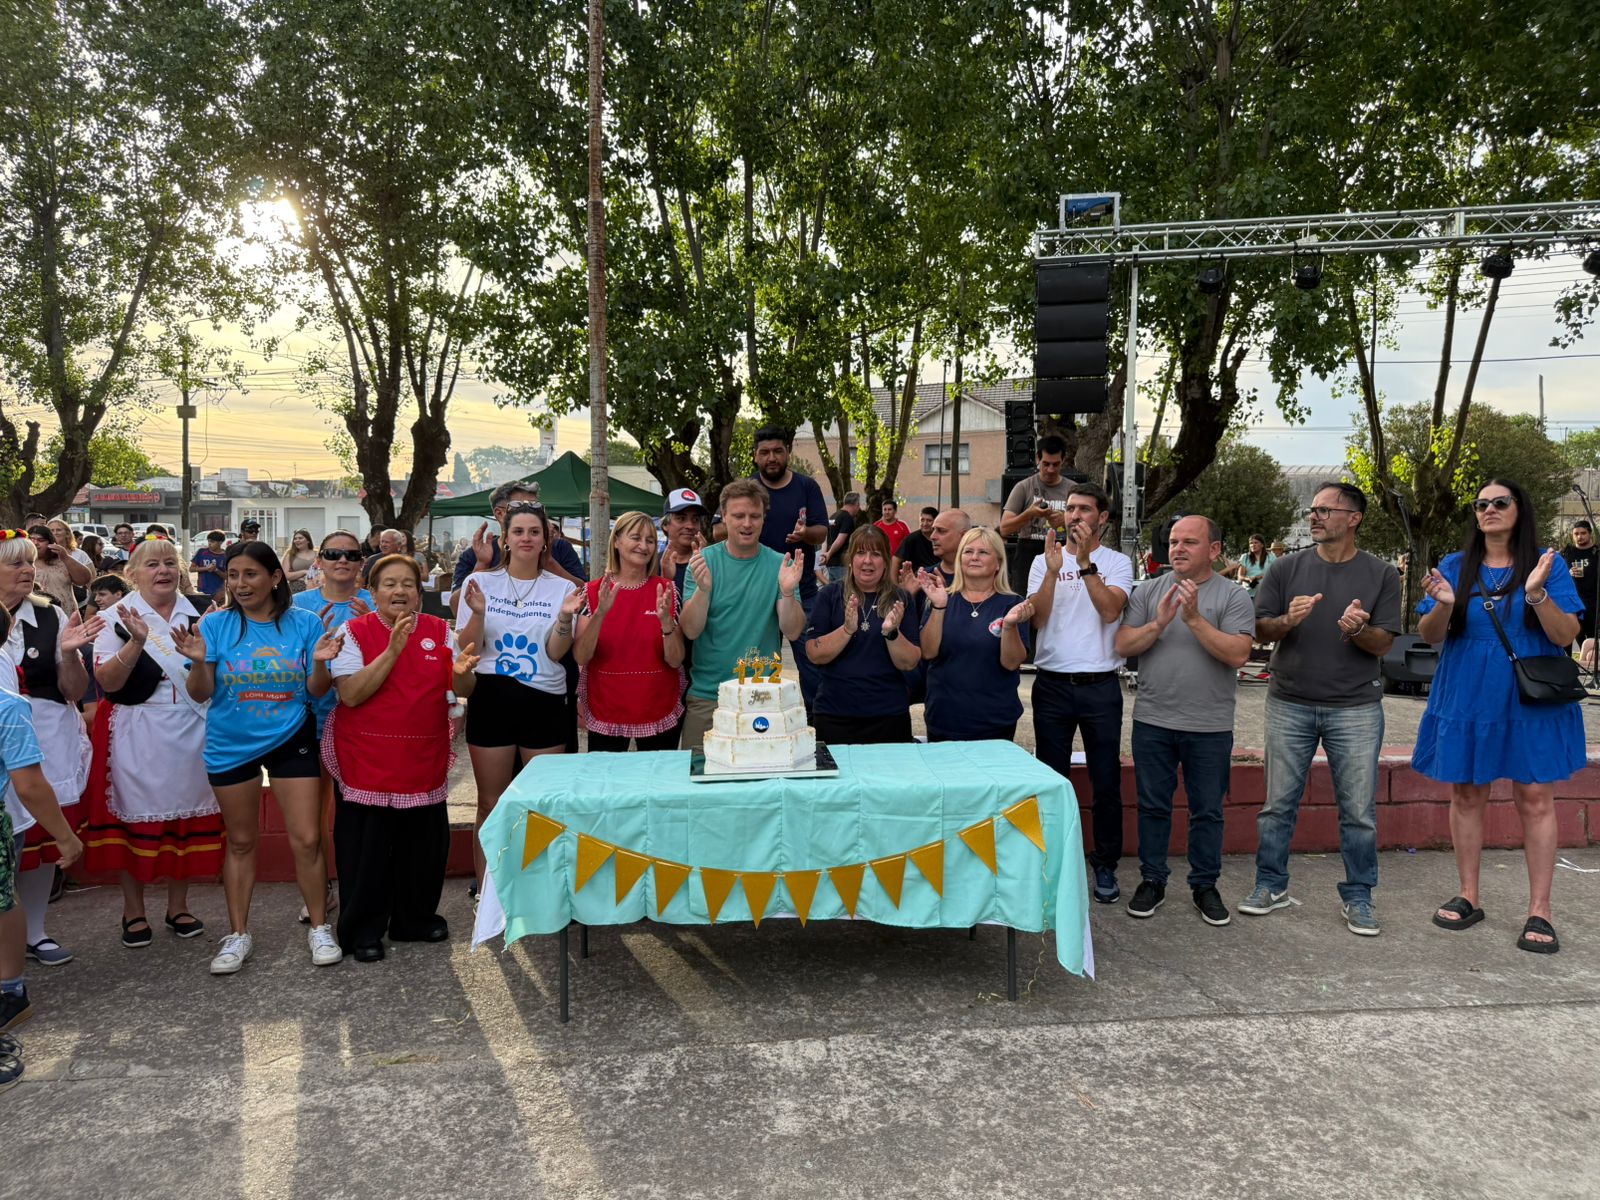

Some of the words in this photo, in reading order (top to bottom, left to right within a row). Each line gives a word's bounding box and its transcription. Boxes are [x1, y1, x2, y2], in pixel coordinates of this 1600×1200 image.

[489, 595, 551, 607] Proteconistas
[487, 605, 551, 618] Independientes
[225, 659, 304, 671] VERANO
[223, 671, 305, 686] DORADO
[733, 660, 783, 685] 122
